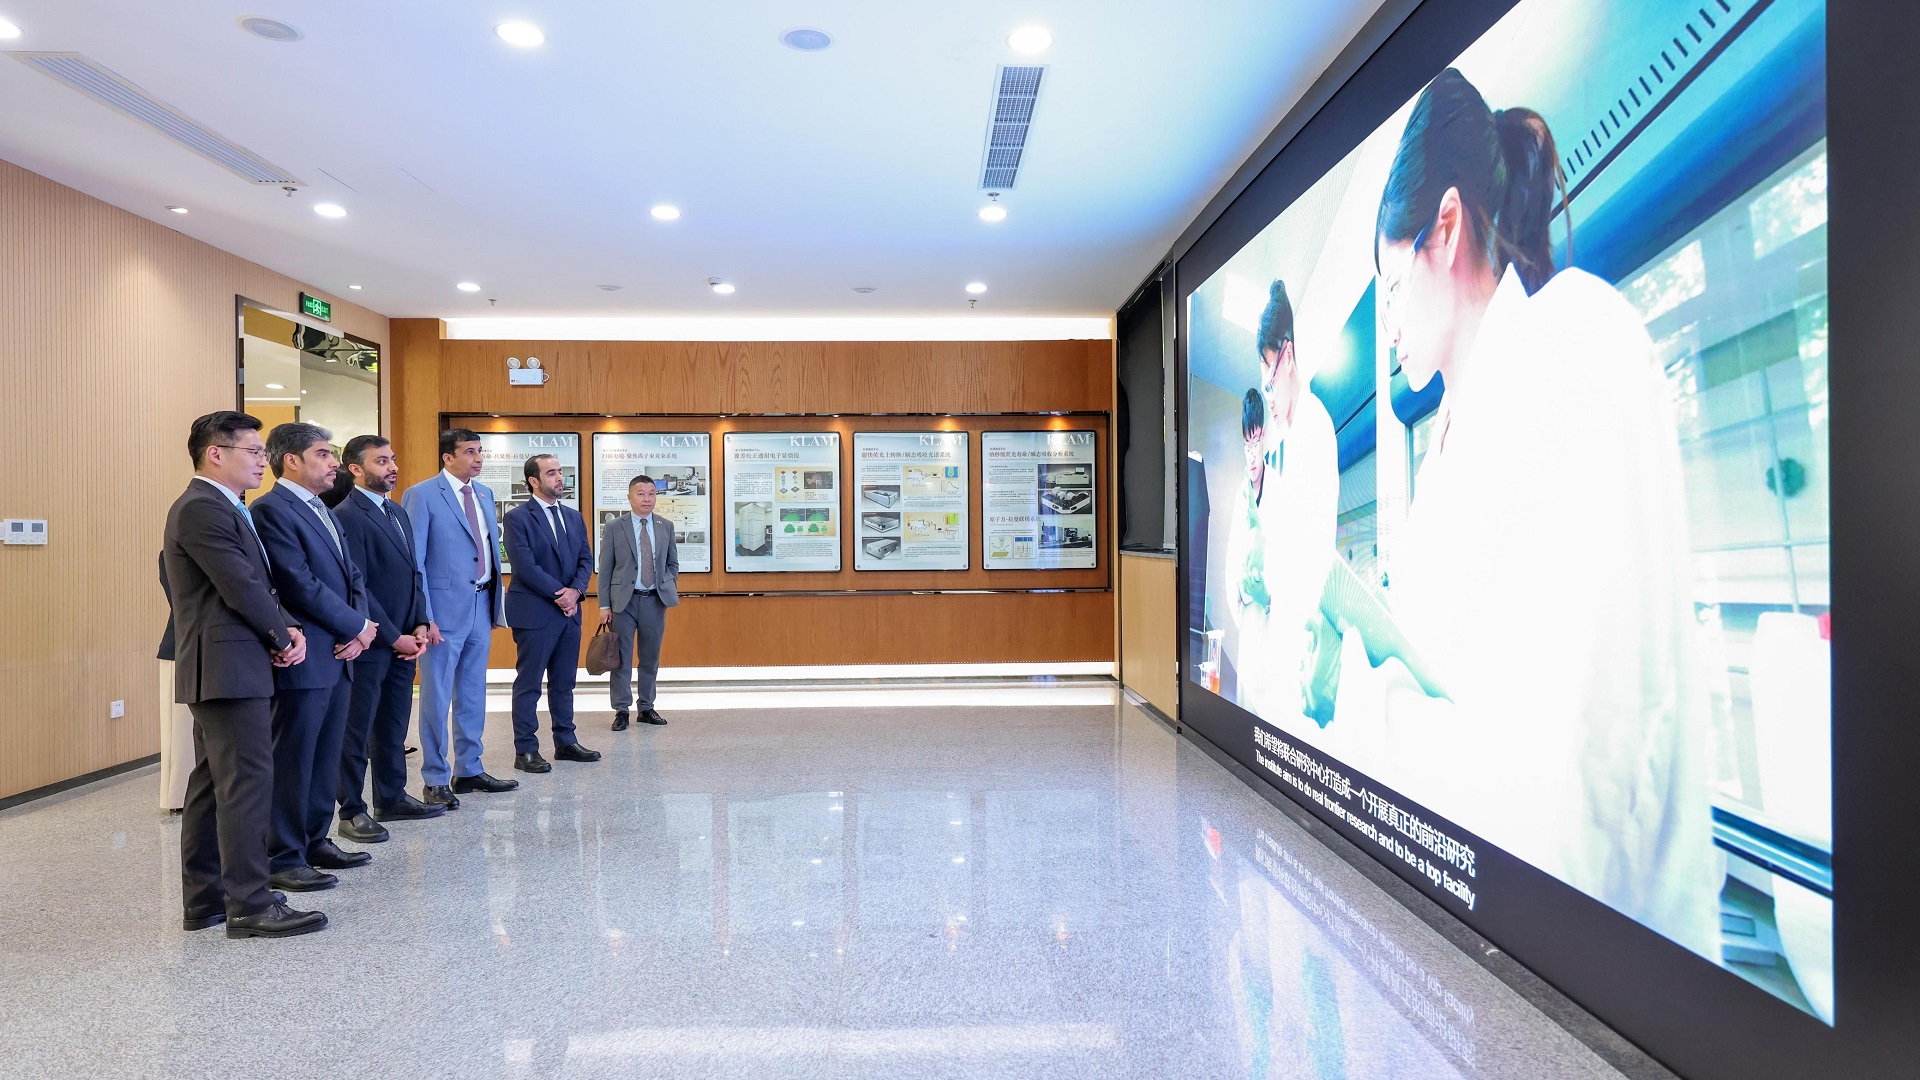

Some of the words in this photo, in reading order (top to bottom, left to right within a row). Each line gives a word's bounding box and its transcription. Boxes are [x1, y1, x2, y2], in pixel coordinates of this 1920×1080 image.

[528, 435, 574, 448] KLAM
[660, 435, 704, 448] KLAM
[790, 435, 834, 447] KLAM
[918, 434, 963, 446] KLAM
[1046, 433, 1091, 445] KLAM
[1254, 726, 1476, 878] 我们希望将联合研究中心打造成一个开展真正的前沿研究
[1255, 749, 1265, 765] The
[1264, 755, 1282, 777] institute
[1282, 768, 1292, 785] aim
[1292, 773, 1298, 788] is
[1298, 777, 1304, 792] to
[1304, 782, 1312, 797] do
[1312, 789, 1324, 806] real
[1324, 794, 1347, 820] frontier
[1346, 811, 1377, 842] research
[1378, 832, 1394, 853] and
[1395, 839, 1404, 859] to
[1404, 845, 1417, 868] be
[1418, 858, 1425, 874] a
[1426, 860, 1442, 887] top
[1443, 870, 1476, 910] facility
